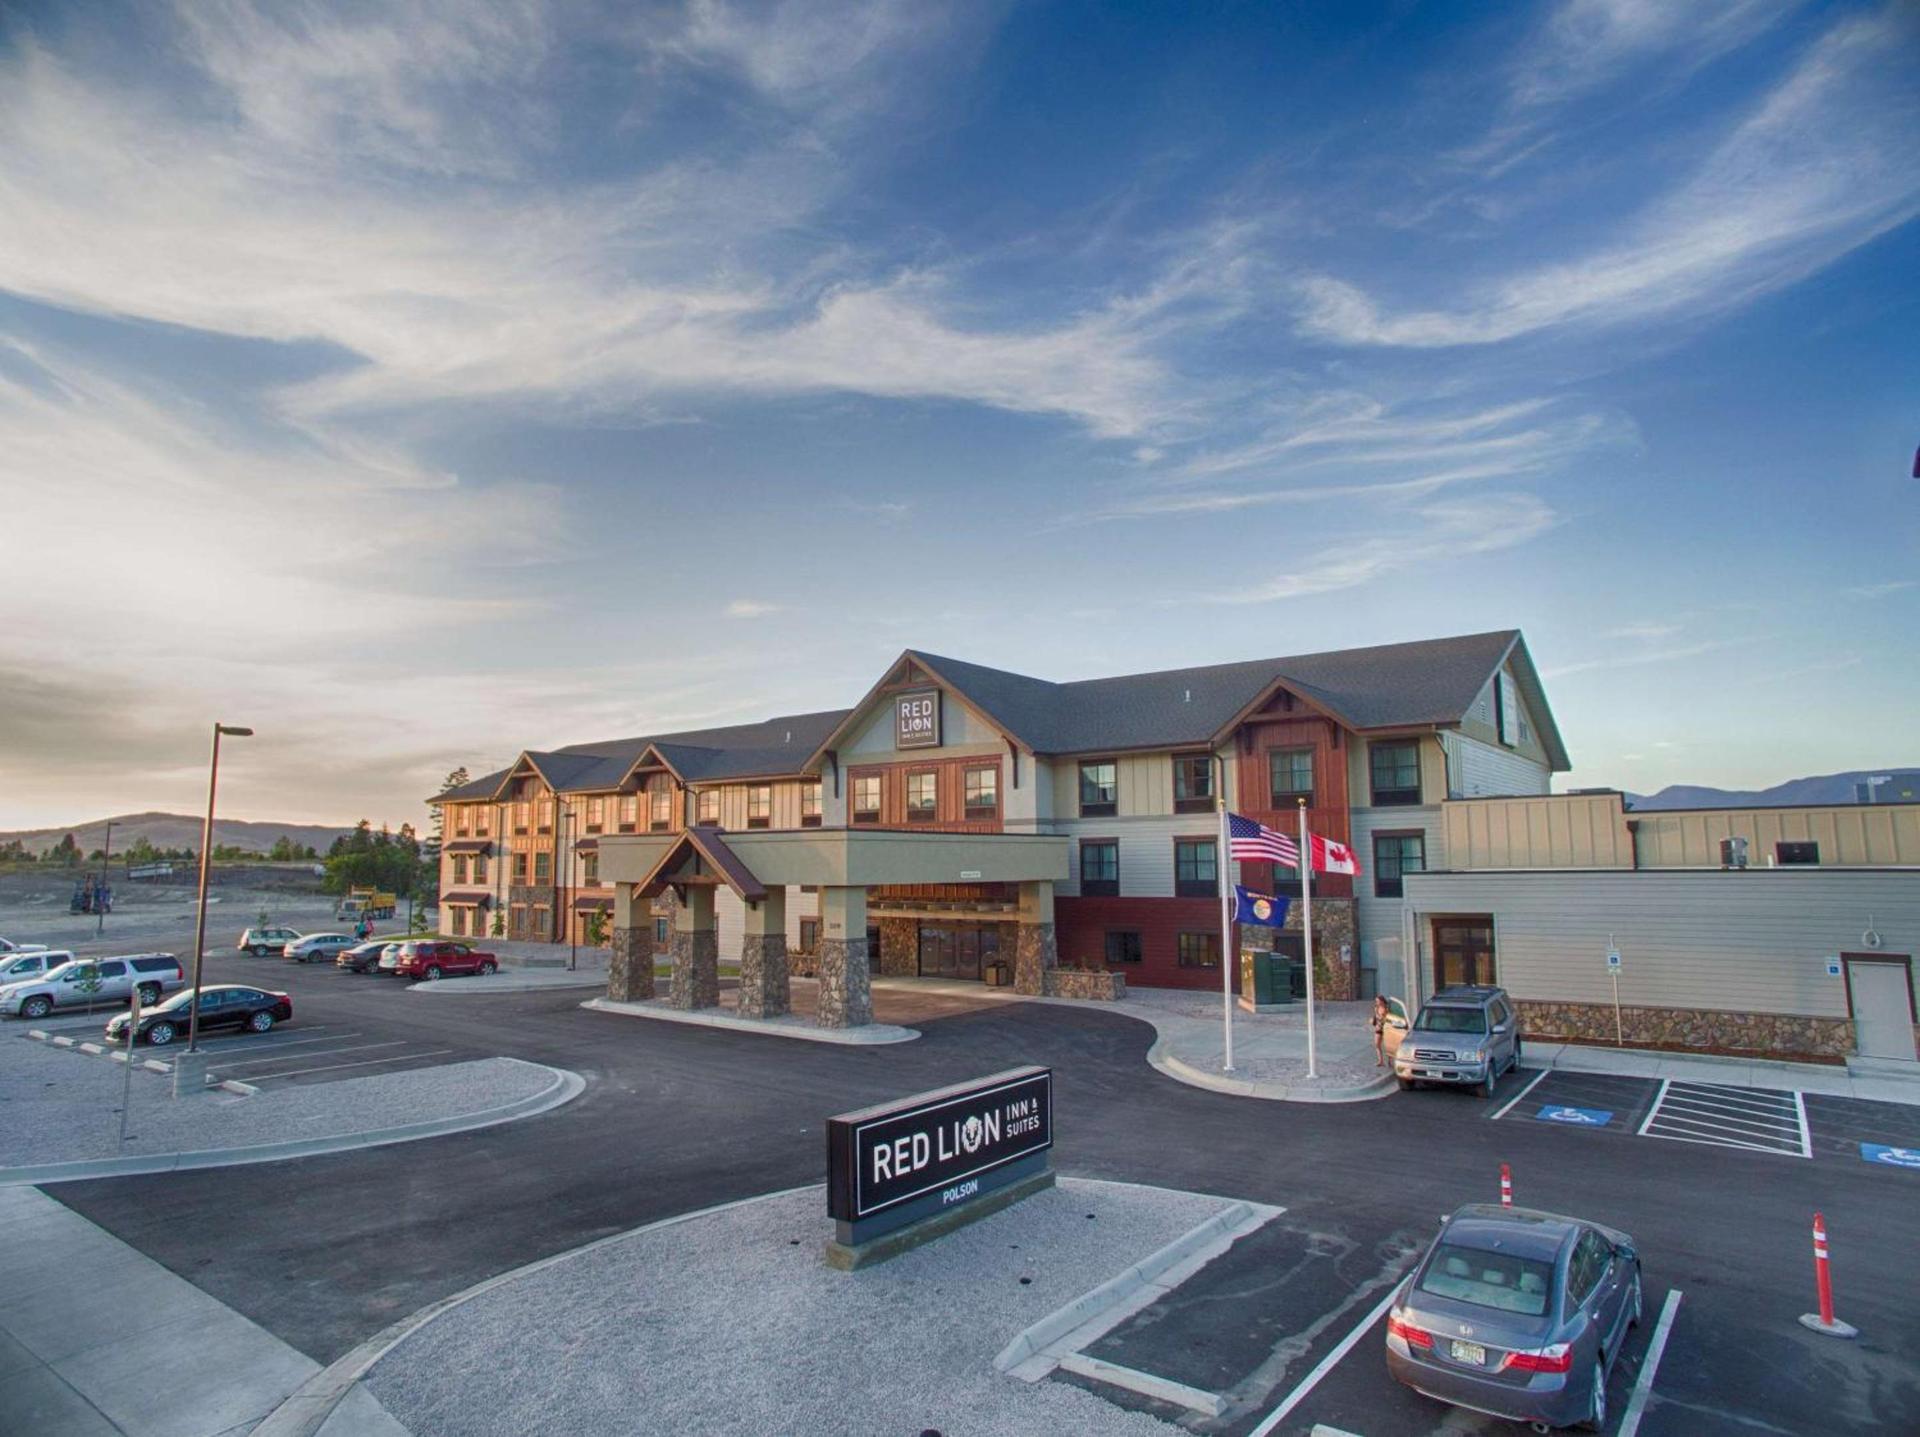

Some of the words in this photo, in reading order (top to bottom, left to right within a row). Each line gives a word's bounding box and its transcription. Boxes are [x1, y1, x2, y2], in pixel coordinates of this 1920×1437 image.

[901, 700, 932, 718] RED
[901, 717, 932, 732] LION
[1006, 1101, 1028, 1121] INN
[1032, 1097, 1039, 1112] &
[1006, 1115, 1040, 1138] SUITES
[873, 1131, 930, 1184] RED
[938, 1109, 1000, 1162] LION
[943, 1179, 978, 1204] POLSON
